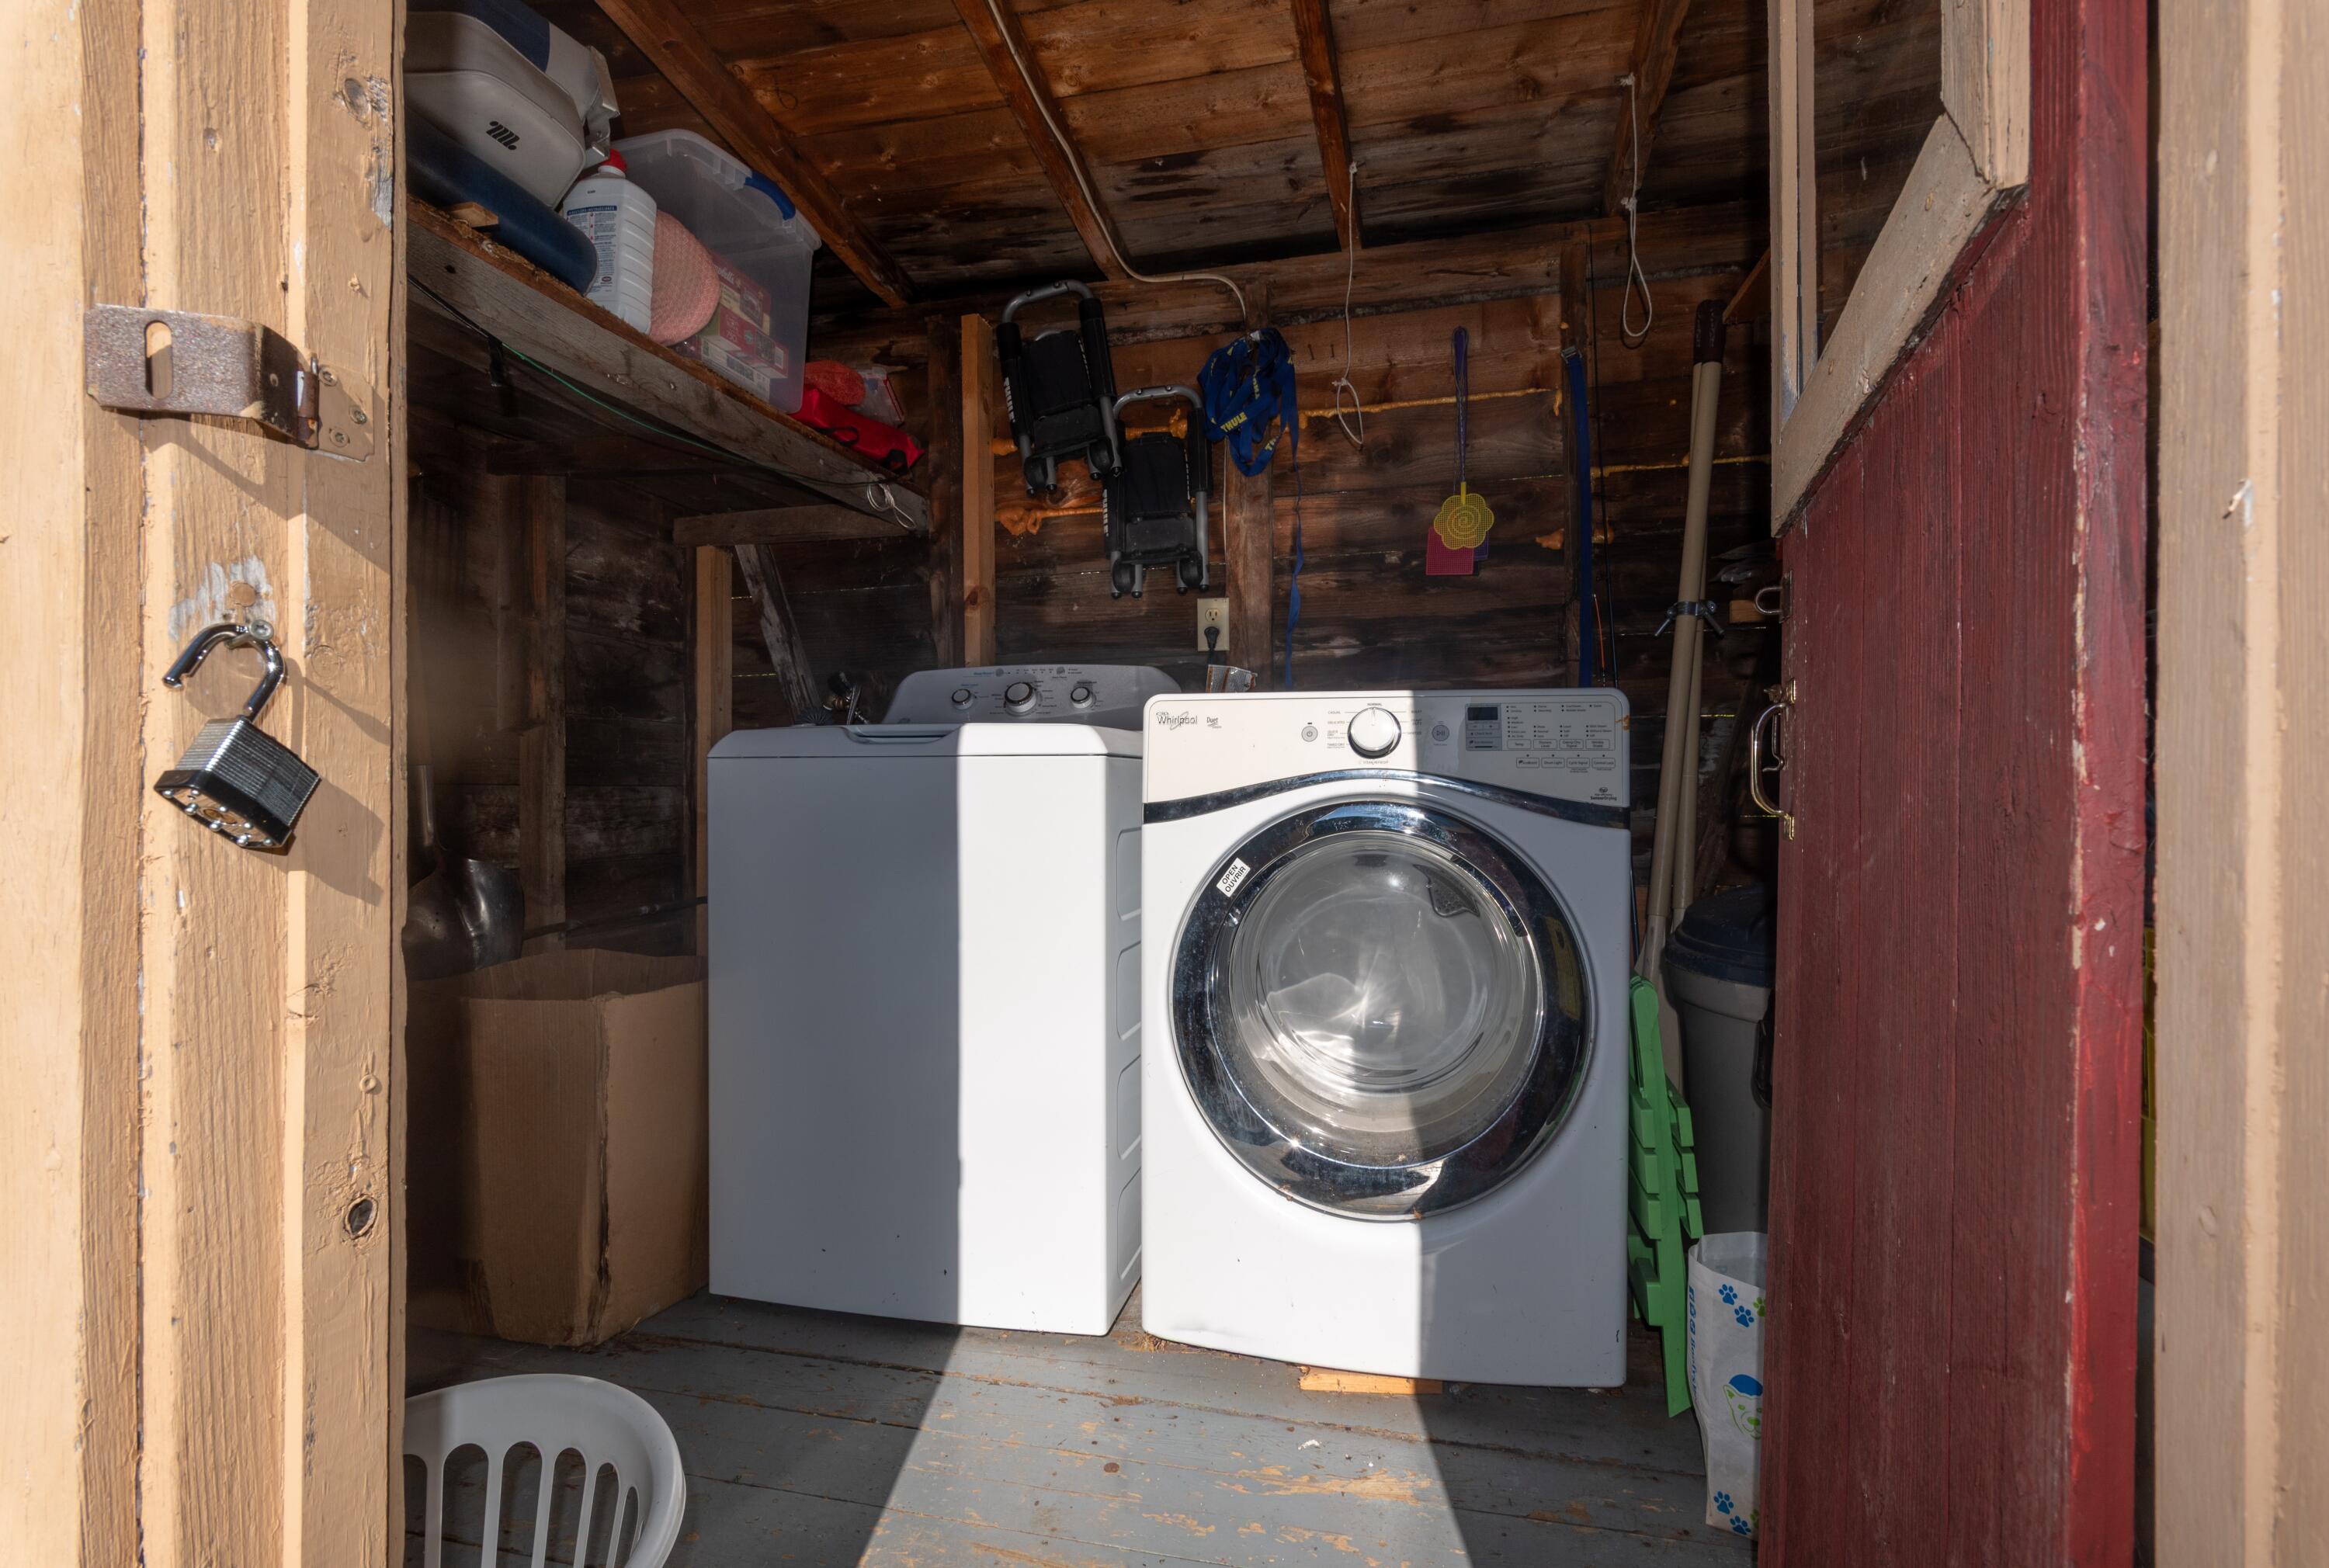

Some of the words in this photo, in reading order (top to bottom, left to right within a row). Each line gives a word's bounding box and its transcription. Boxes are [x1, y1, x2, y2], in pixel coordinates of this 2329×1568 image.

[1219, 411, 1248, 433] THULE
[1157, 715, 1198, 727] Whirlpool
[1222, 864, 1238, 885] OPEN
[1225, 866, 1246, 893] OUVRIR
